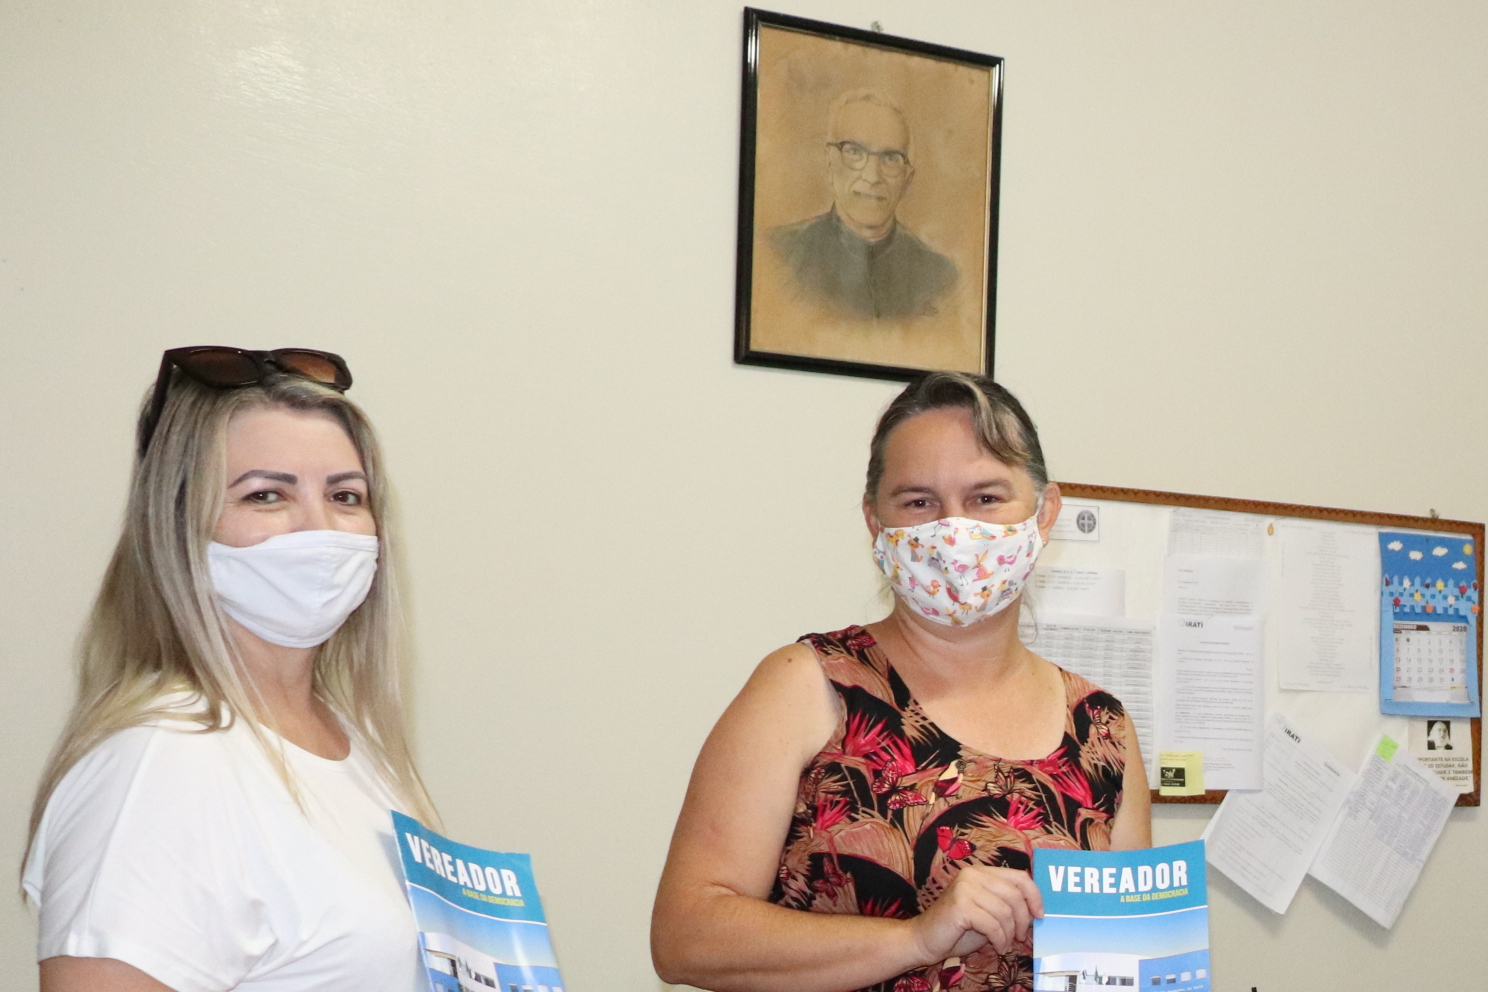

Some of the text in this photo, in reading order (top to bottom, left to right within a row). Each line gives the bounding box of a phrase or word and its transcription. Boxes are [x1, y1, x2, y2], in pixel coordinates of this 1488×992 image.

[1284, 728, 1301, 743] IRATI
[405, 832, 522, 897] VEREADOR
[1048, 860, 1189, 894] VEREADOR
[1142, 893, 1151, 902] DA
[1152, 888, 1189, 900] DEMOCRACIA
